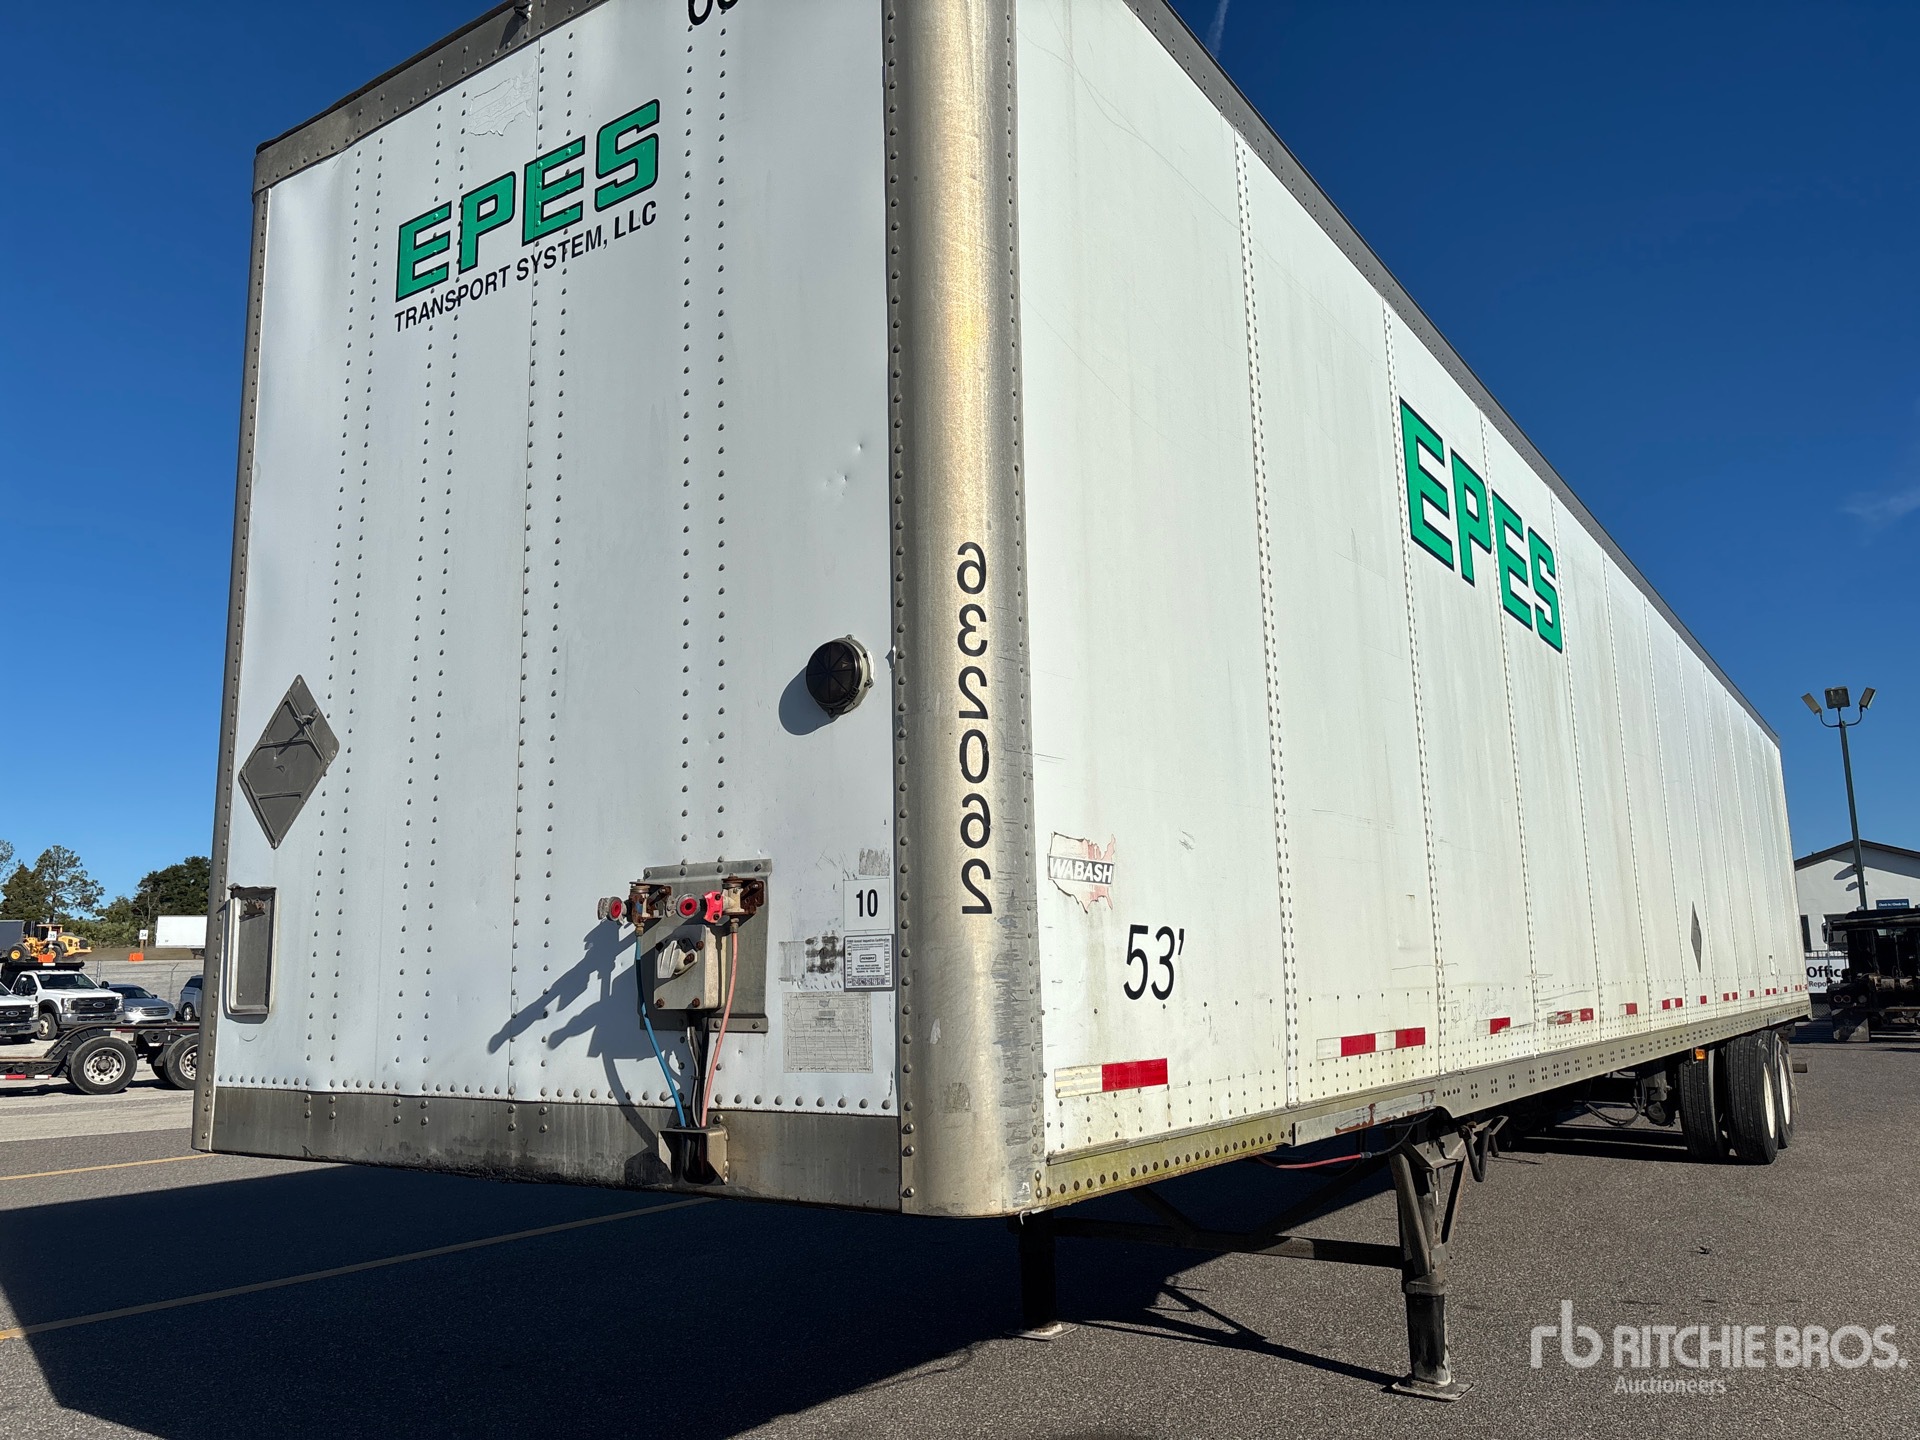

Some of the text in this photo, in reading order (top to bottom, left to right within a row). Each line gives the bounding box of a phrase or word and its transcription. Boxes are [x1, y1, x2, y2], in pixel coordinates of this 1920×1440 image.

[395, 98, 661, 303] EPES
[394, 200, 657, 332] TRANSPORT SYSTEM, LLC
[1398, 394, 1563, 654] EPES
[1049, 856, 1114, 884] WABASH
[856, 888, 879, 918] 10
[1123, 923, 1185, 1001] 53'
[1806, 965, 1843, 978] Offic
[1808, 980, 1828, 988] Repo
